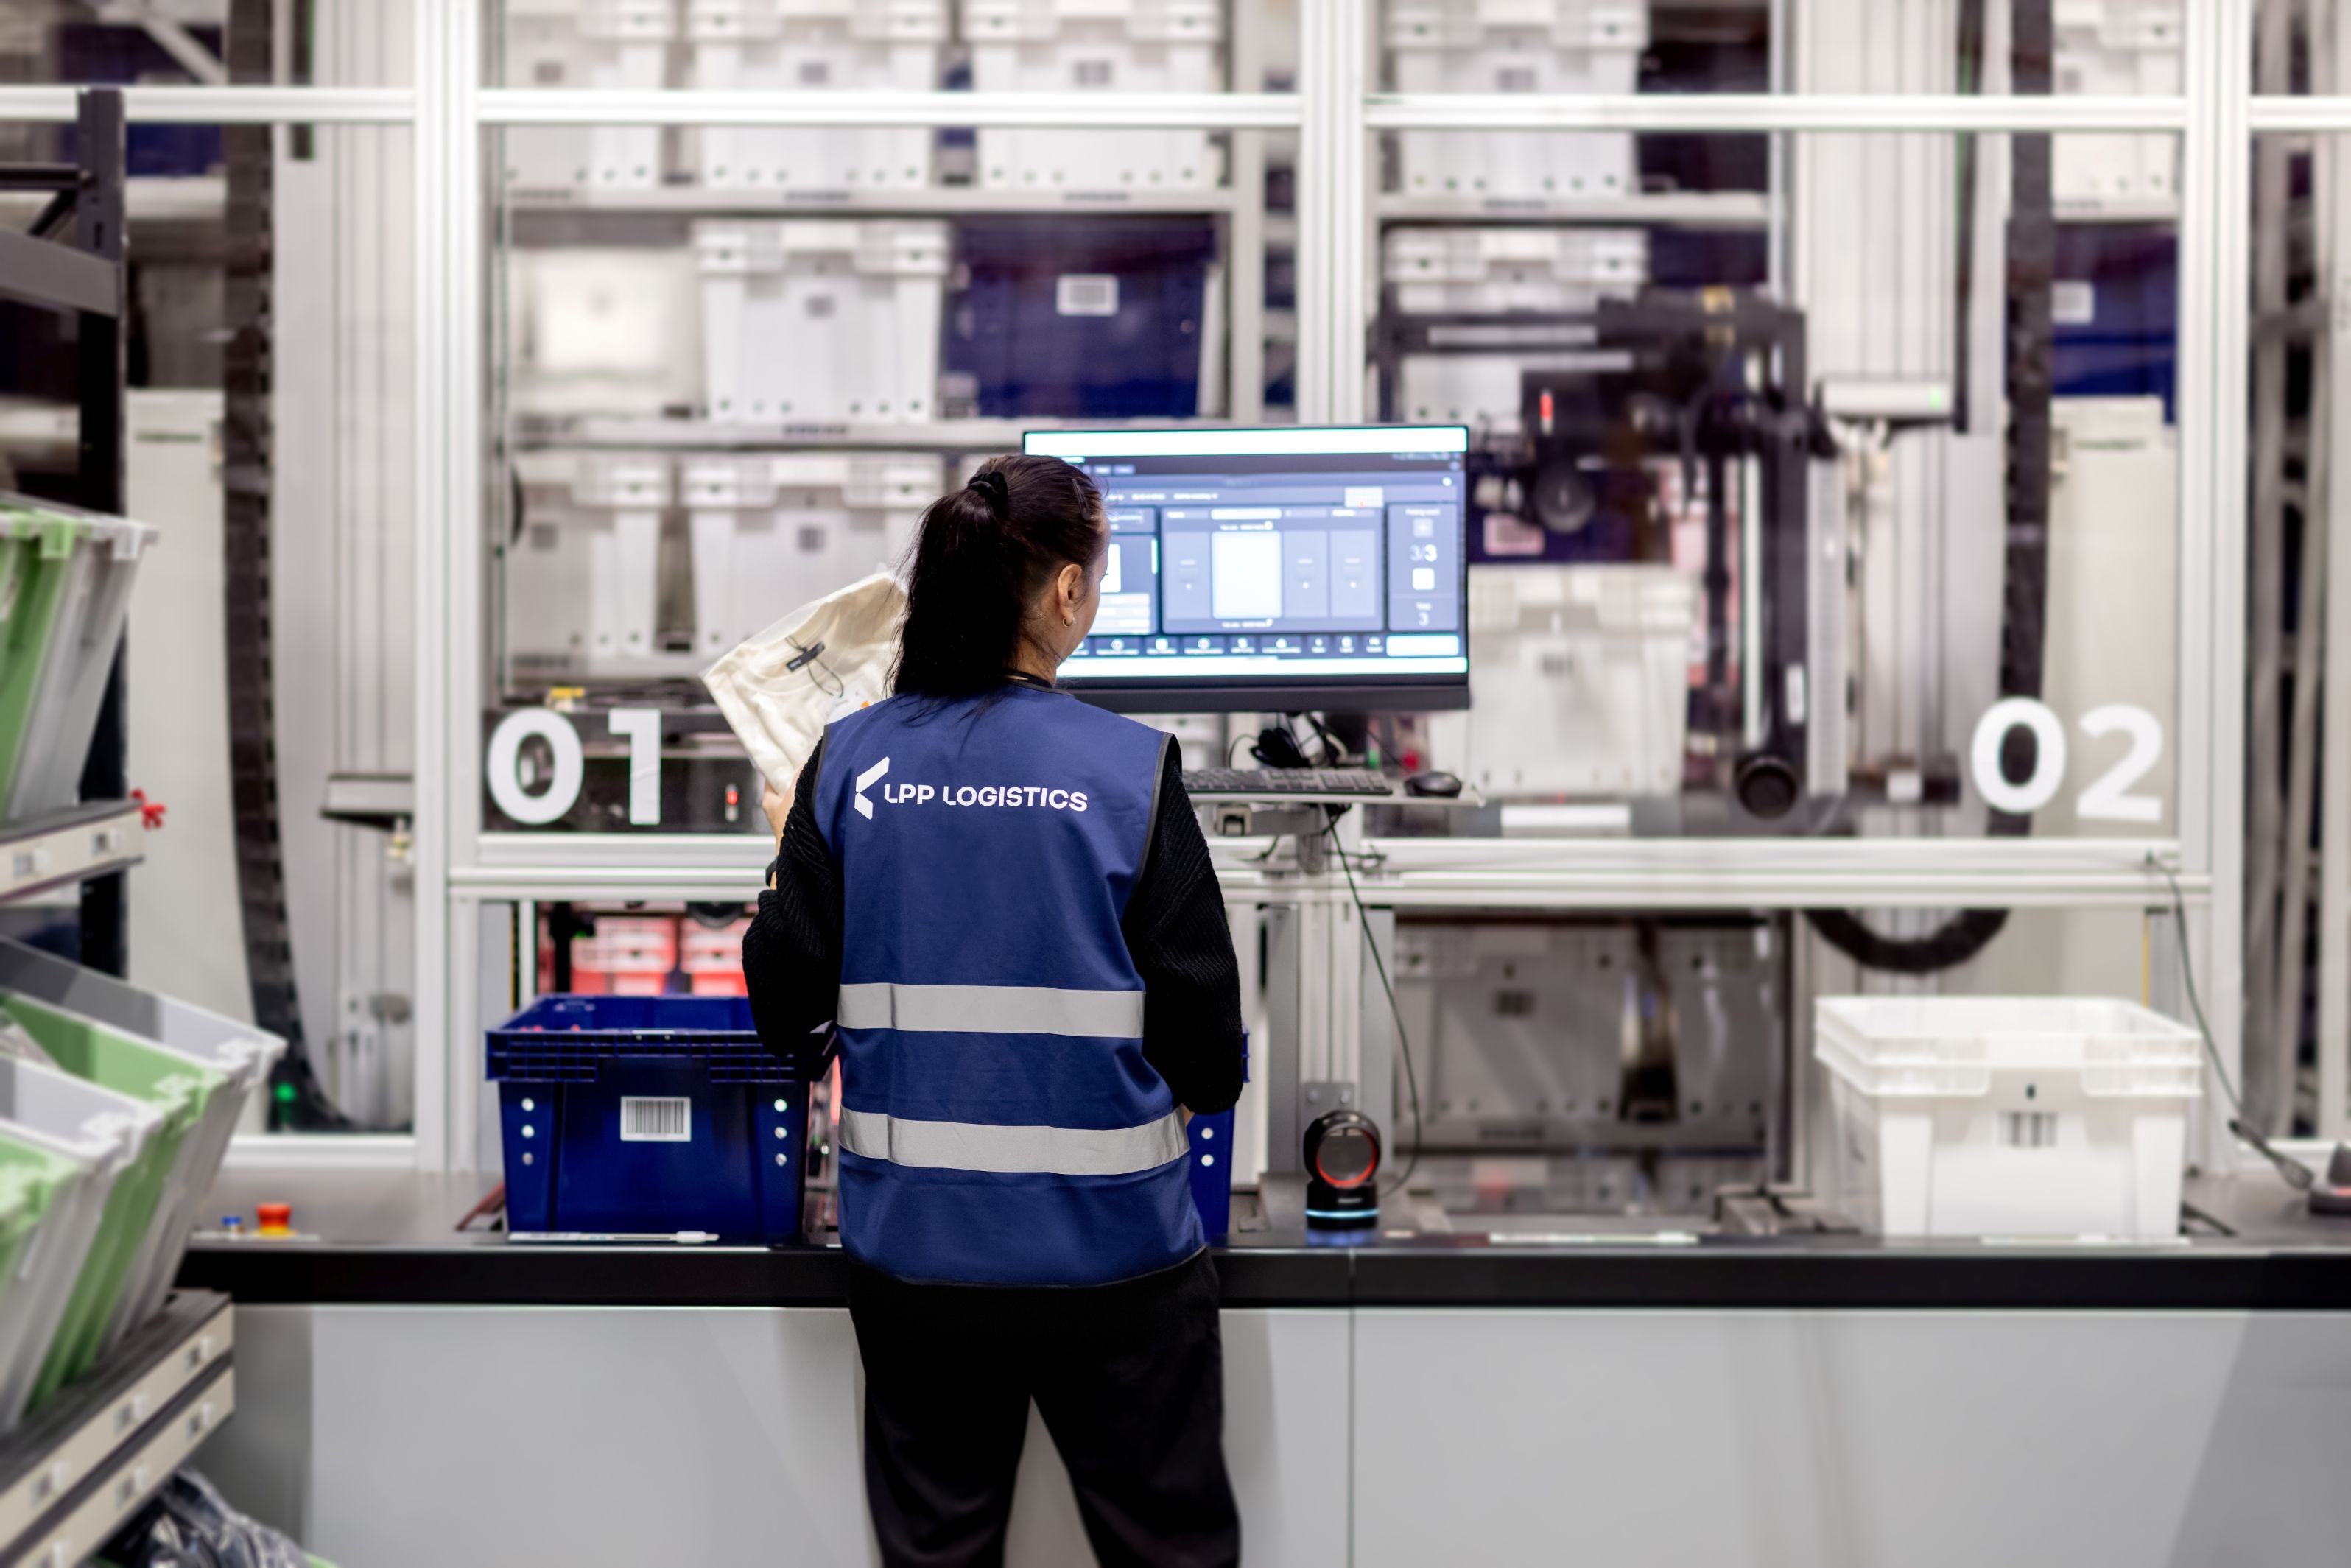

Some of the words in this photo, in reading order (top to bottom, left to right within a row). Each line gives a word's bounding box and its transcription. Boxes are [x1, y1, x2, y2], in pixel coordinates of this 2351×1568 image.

[488, 706, 661, 825] 01
[884, 784, 935, 804] LPP
[943, 785, 1088, 812] LOGISTICS
[1971, 697, 2163, 823] 02
